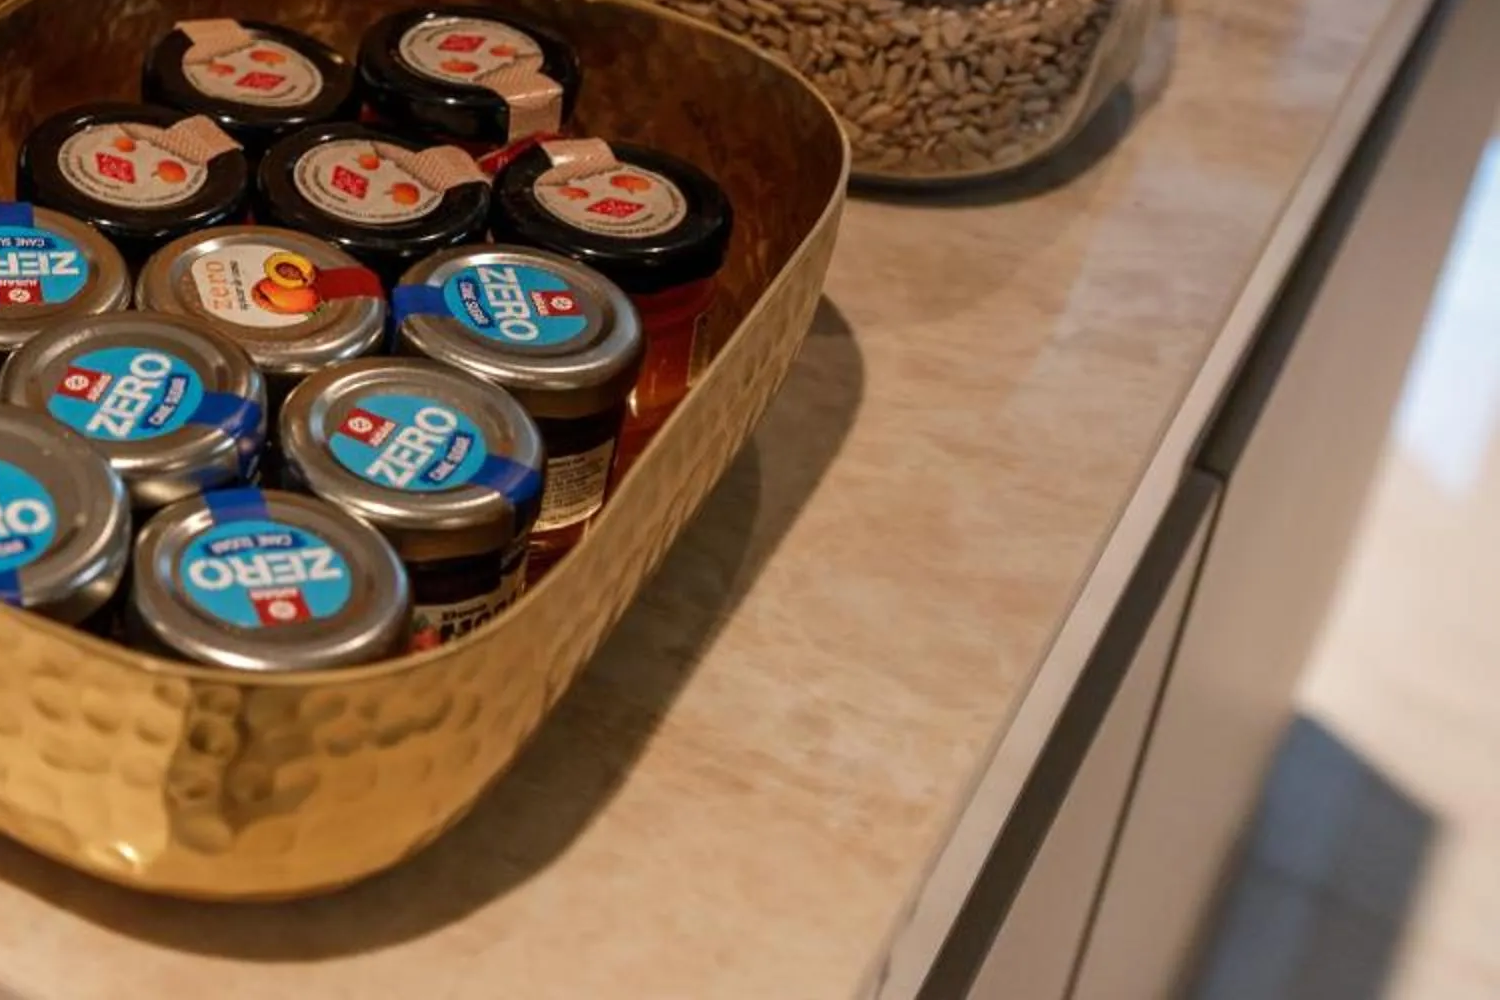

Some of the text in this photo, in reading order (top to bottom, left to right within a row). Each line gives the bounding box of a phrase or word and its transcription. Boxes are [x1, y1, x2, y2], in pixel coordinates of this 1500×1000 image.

[15, 238, 45, 248] CANE
[206, 261, 233, 310] zero
[477, 266, 539, 340] ZERO
[86, 352, 172, 437] ZERO
[366, 407, 457, 488] ZERO
[189, 547, 342, 590] ZERO
